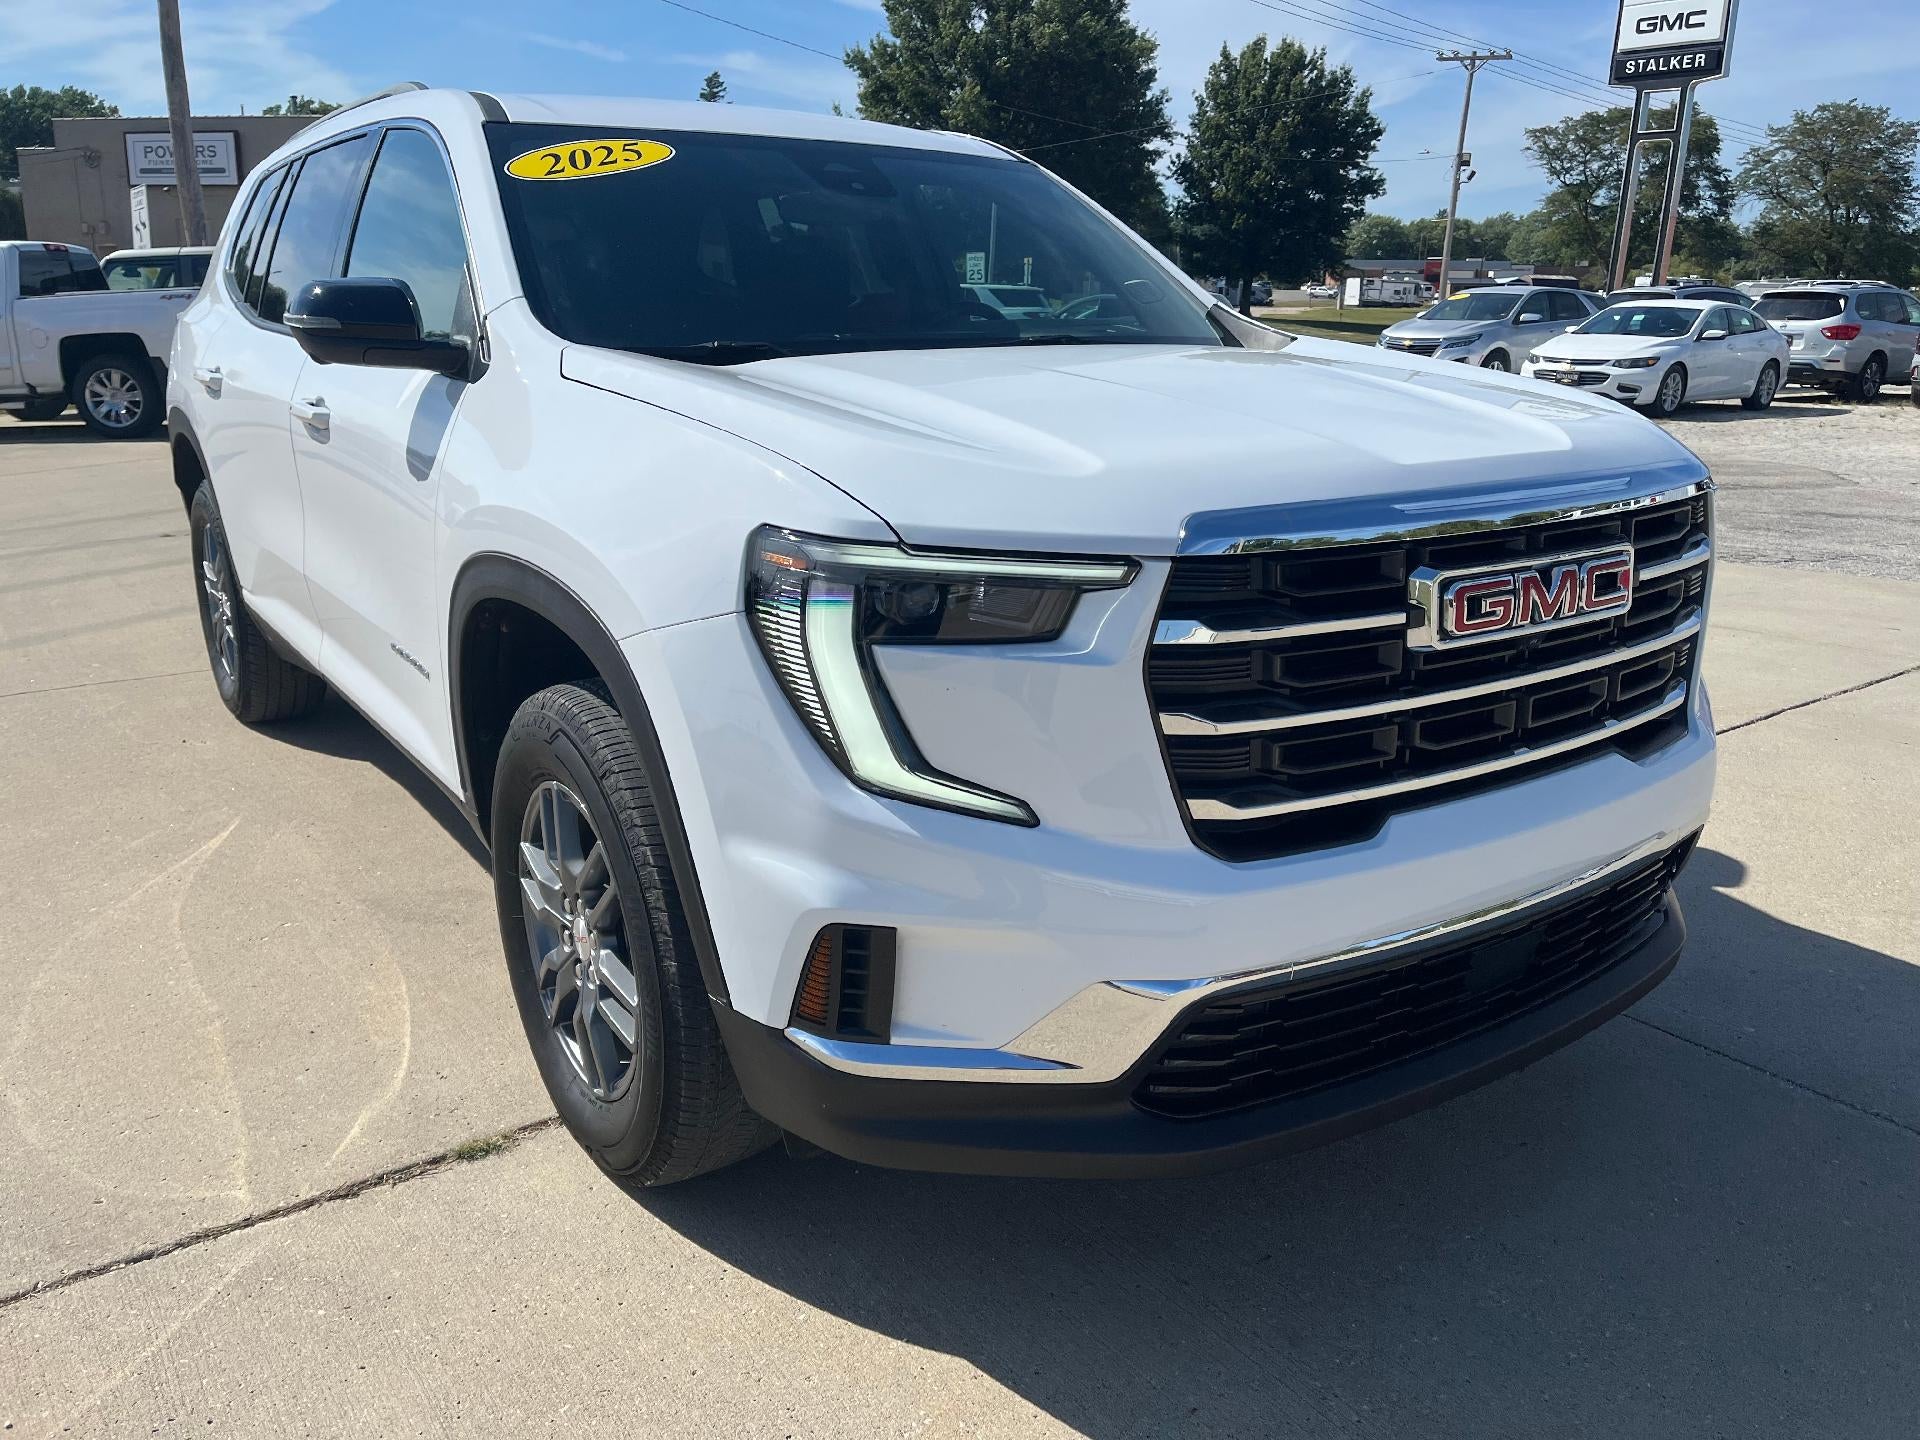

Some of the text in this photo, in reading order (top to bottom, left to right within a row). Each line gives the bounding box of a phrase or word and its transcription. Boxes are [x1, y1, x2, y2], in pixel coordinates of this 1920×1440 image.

[1636, 10, 1707, 34] GMC
[1625, 53, 1706, 74] STALKER
[143, 145, 217, 158] PORS
[540, 142, 643, 176] 2025
[969, 269, 983, 280] 25
[1445, 554, 1630, 636] GMC
